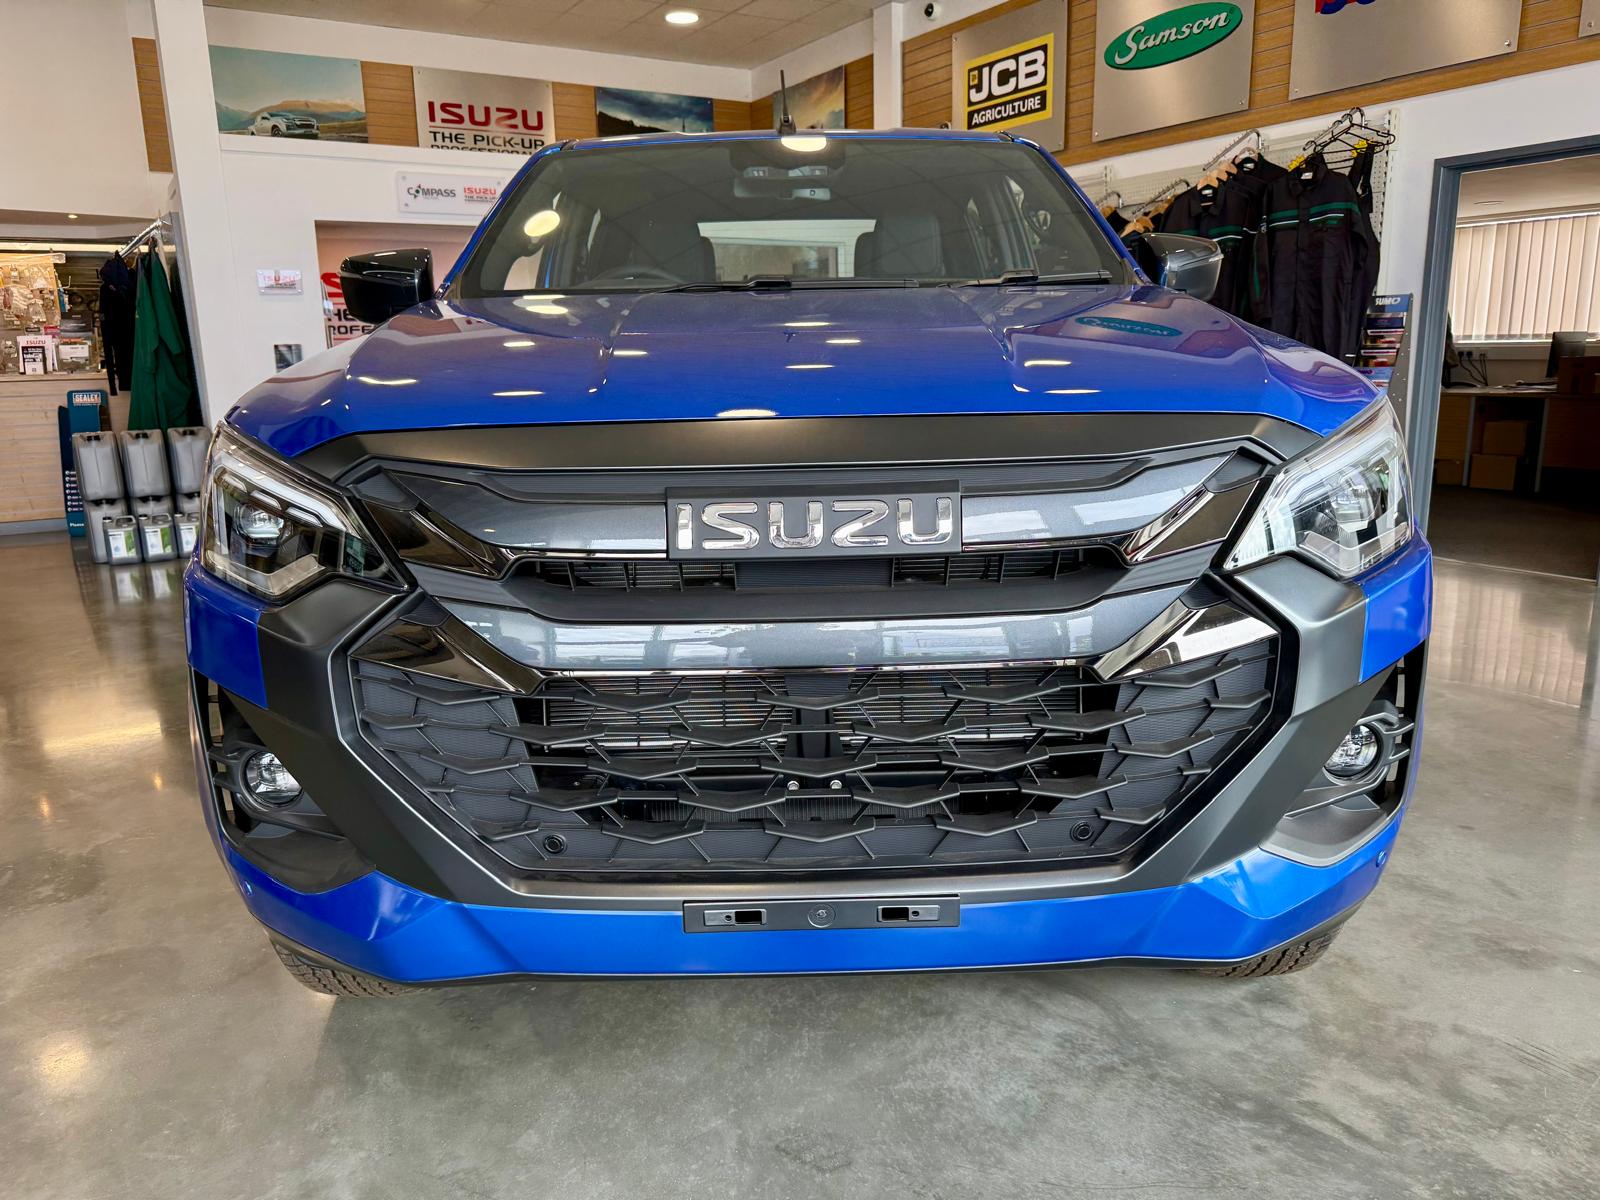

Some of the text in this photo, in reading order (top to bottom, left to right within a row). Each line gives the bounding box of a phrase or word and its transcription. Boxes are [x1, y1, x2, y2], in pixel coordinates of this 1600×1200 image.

[1114, 11, 1230, 65] Samson
[969, 50, 1046, 103] JCB
[428, 101, 544, 131] ISUZU
[971, 95, 1041, 126] AGRICULTURE
[429, 131, 466, 144] THE
[473, 134, 545, 150] PICK-UP
[463, 186, 497, 195] ISUZU
[676, 496, 952, 550] ISUZU
